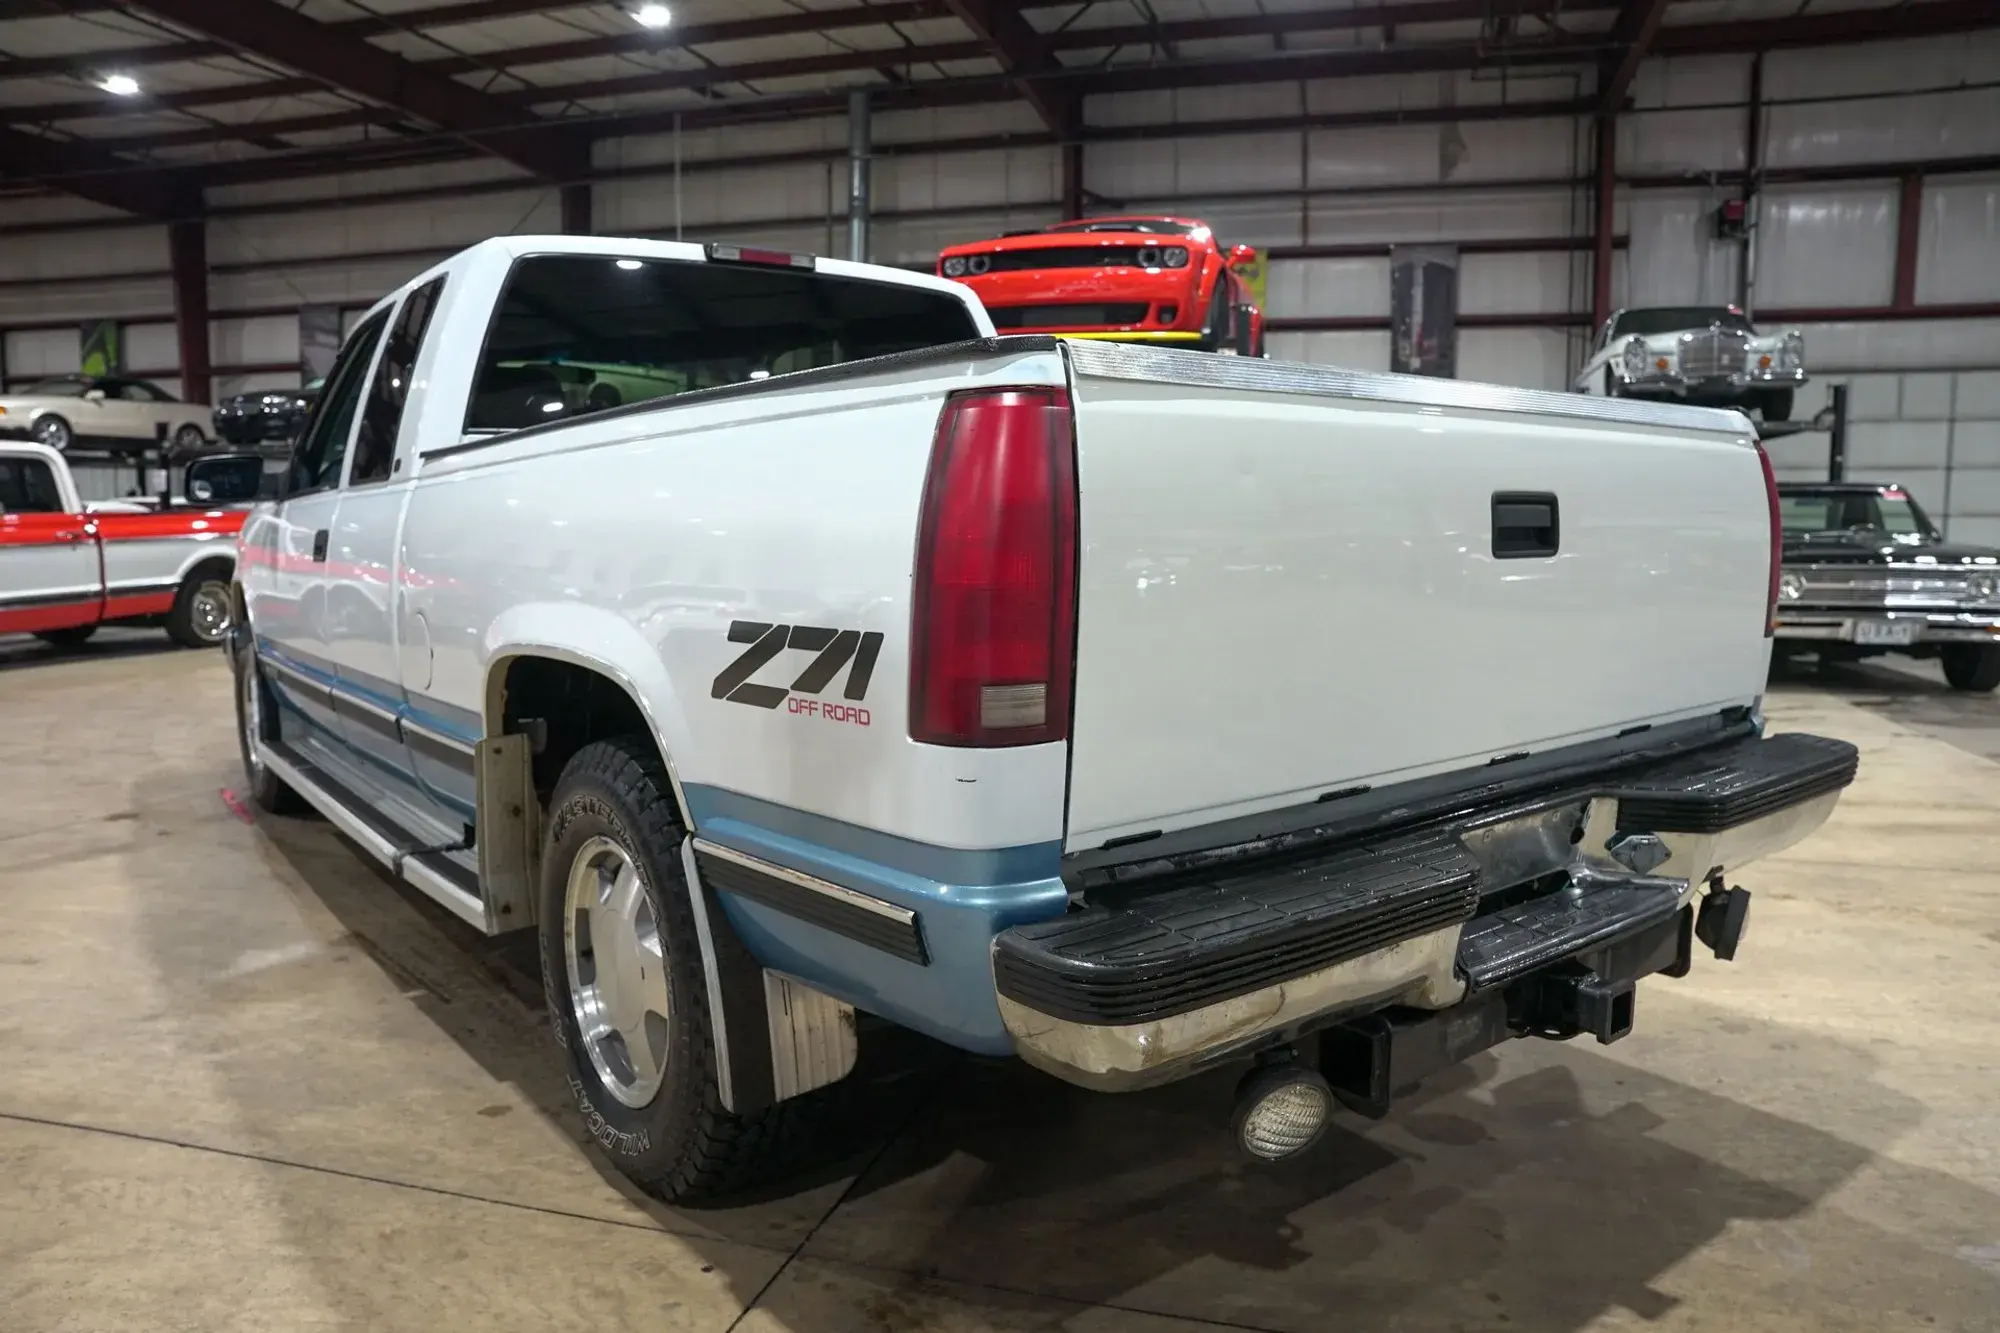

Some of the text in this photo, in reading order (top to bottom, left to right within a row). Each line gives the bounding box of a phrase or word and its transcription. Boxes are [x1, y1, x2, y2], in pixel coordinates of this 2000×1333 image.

[711, 620, 884, 709] Z71
[788, 697, 870, 726] OFF ROAD
[567, 1074, 651, 1157] WILDCAT
